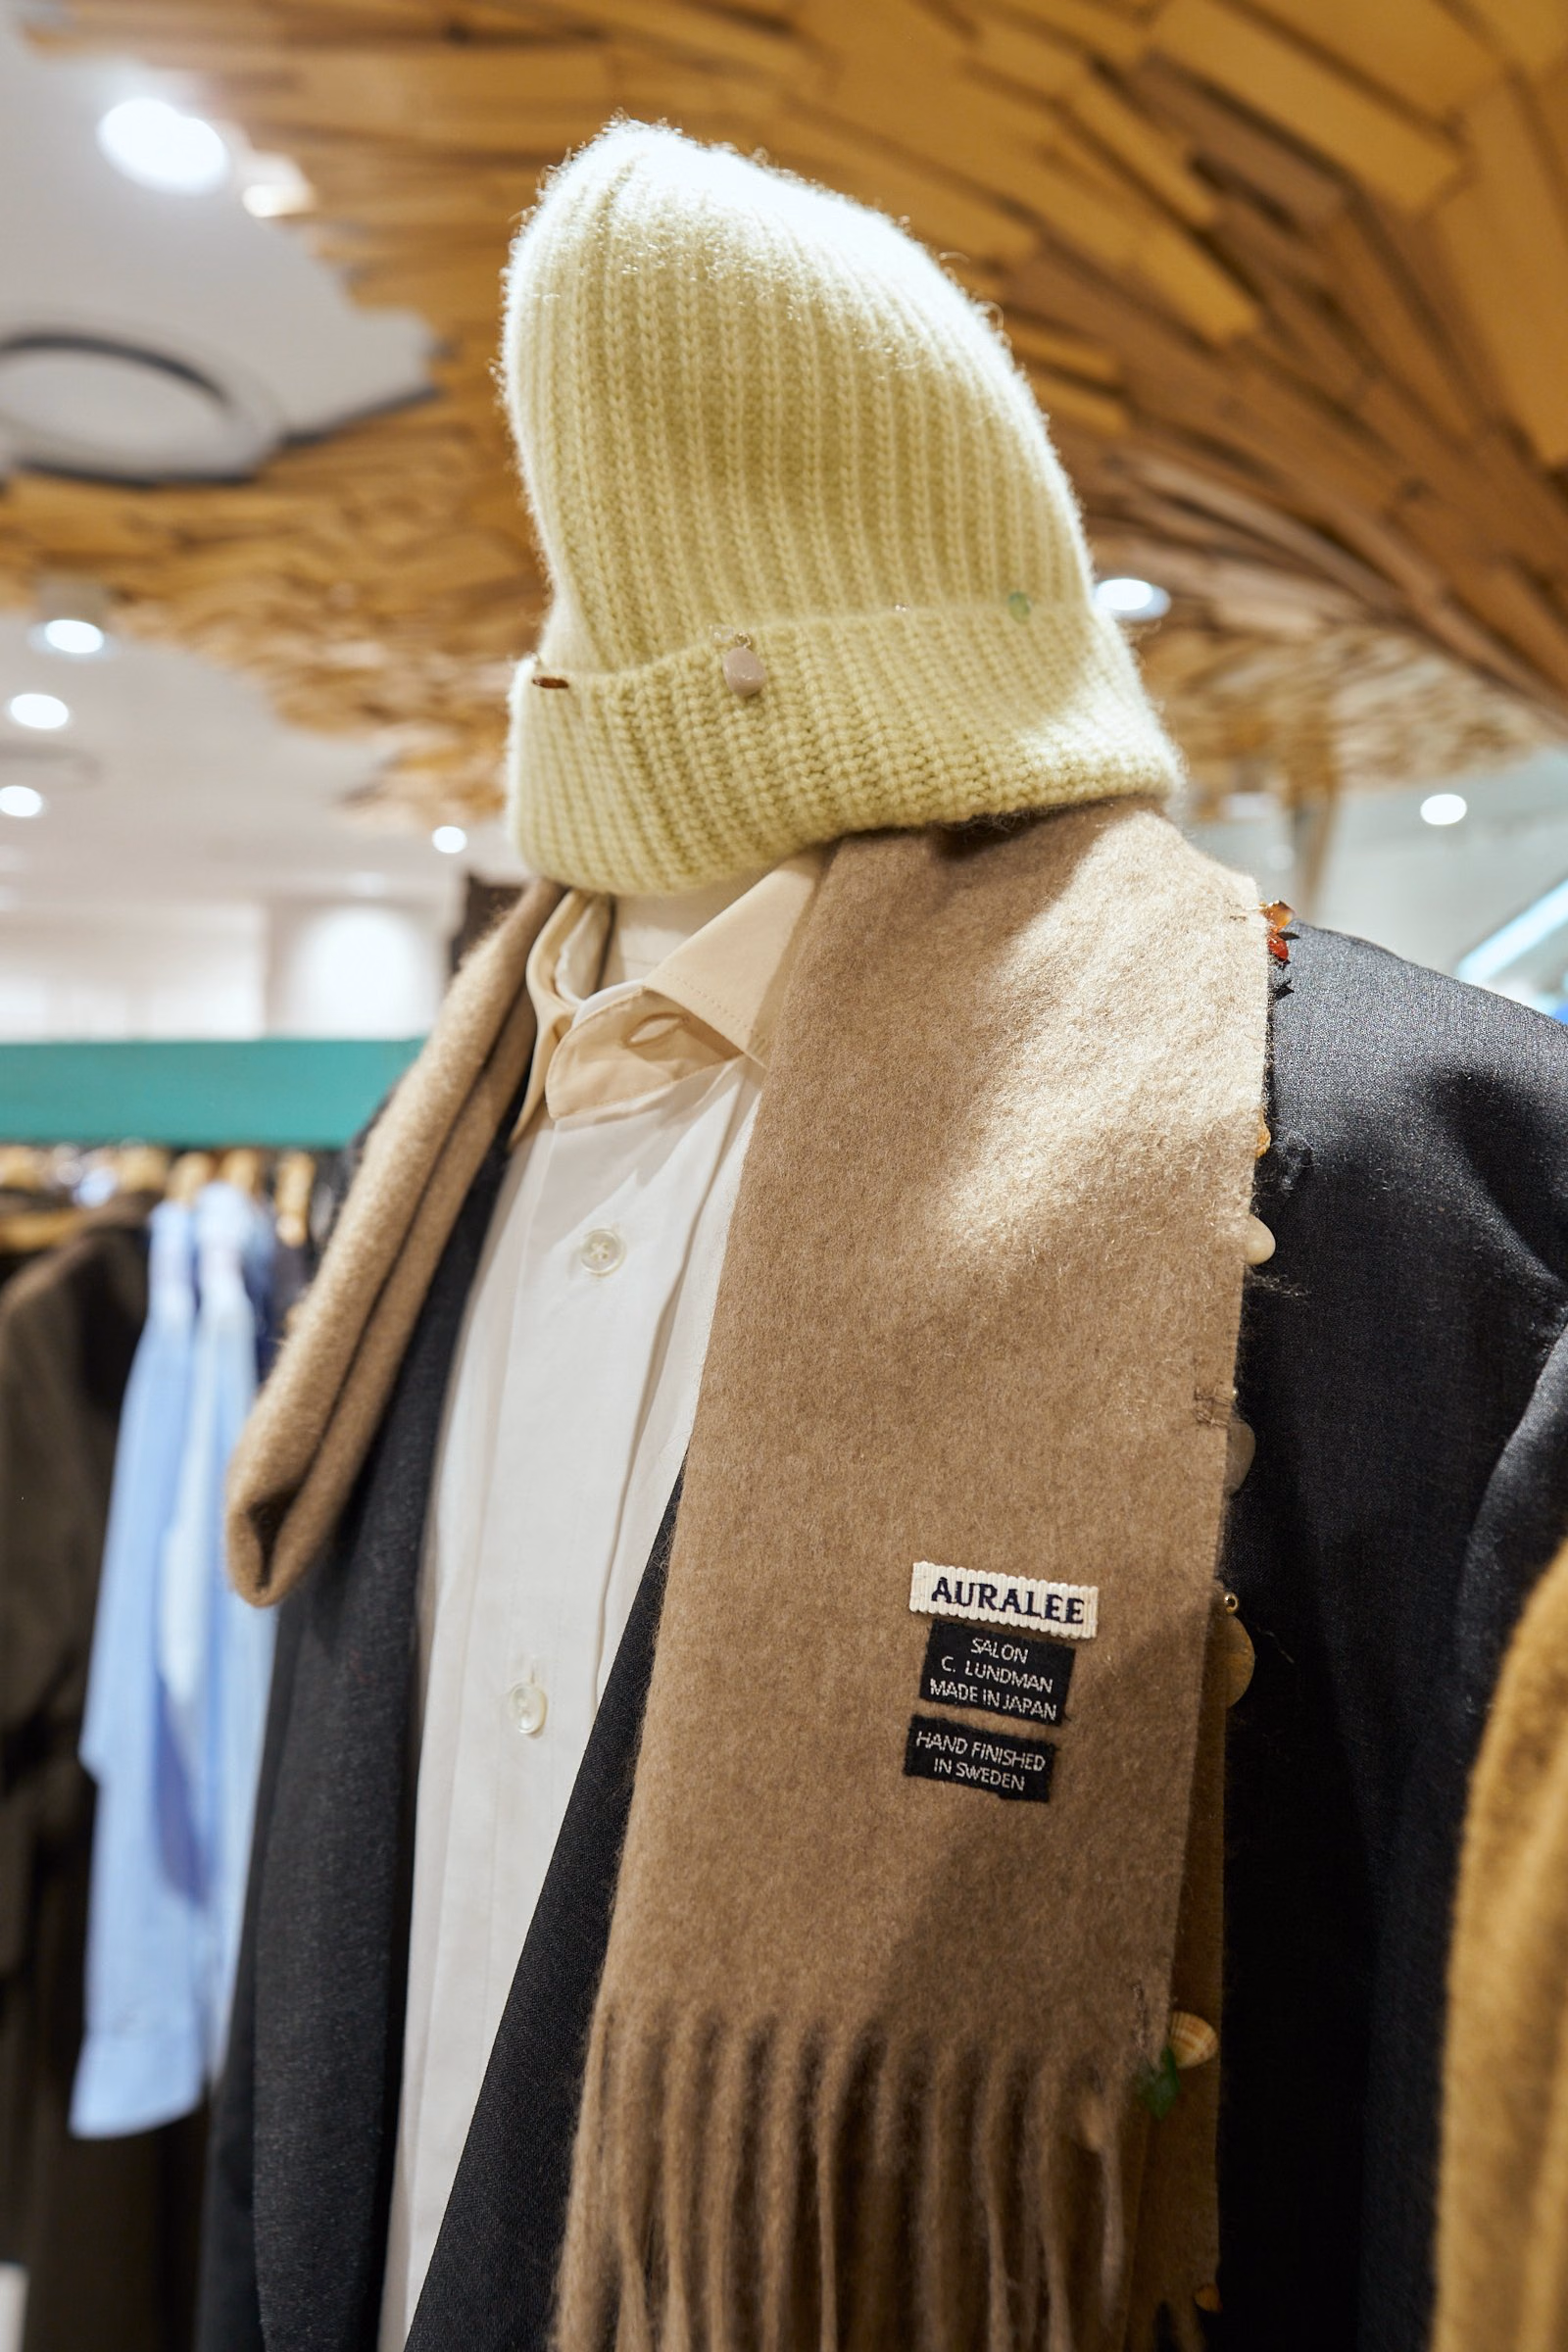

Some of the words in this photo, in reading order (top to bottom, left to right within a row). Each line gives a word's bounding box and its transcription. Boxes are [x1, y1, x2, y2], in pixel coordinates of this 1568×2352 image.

[931, 1576, 1085, 1625] AURALEE
[970, 1637, 1029, 1664] SALON
[941, 1655, 956, 1673] C.
[964, 1660, 1054, 1693] LUNDMAN
[930, 1678, 978, 1703] MADE
[982, 1689, 1000, 1708] IN
[1003, 1693, 1057, 1721] JAPAN
[916, 1731, 968, 1754] HAND
[971, 1741, 1047, 1772] FINISHED
[934, 1757, 952, 1774] IN
[956, 1761, 1025, 1791] SWEDEN
